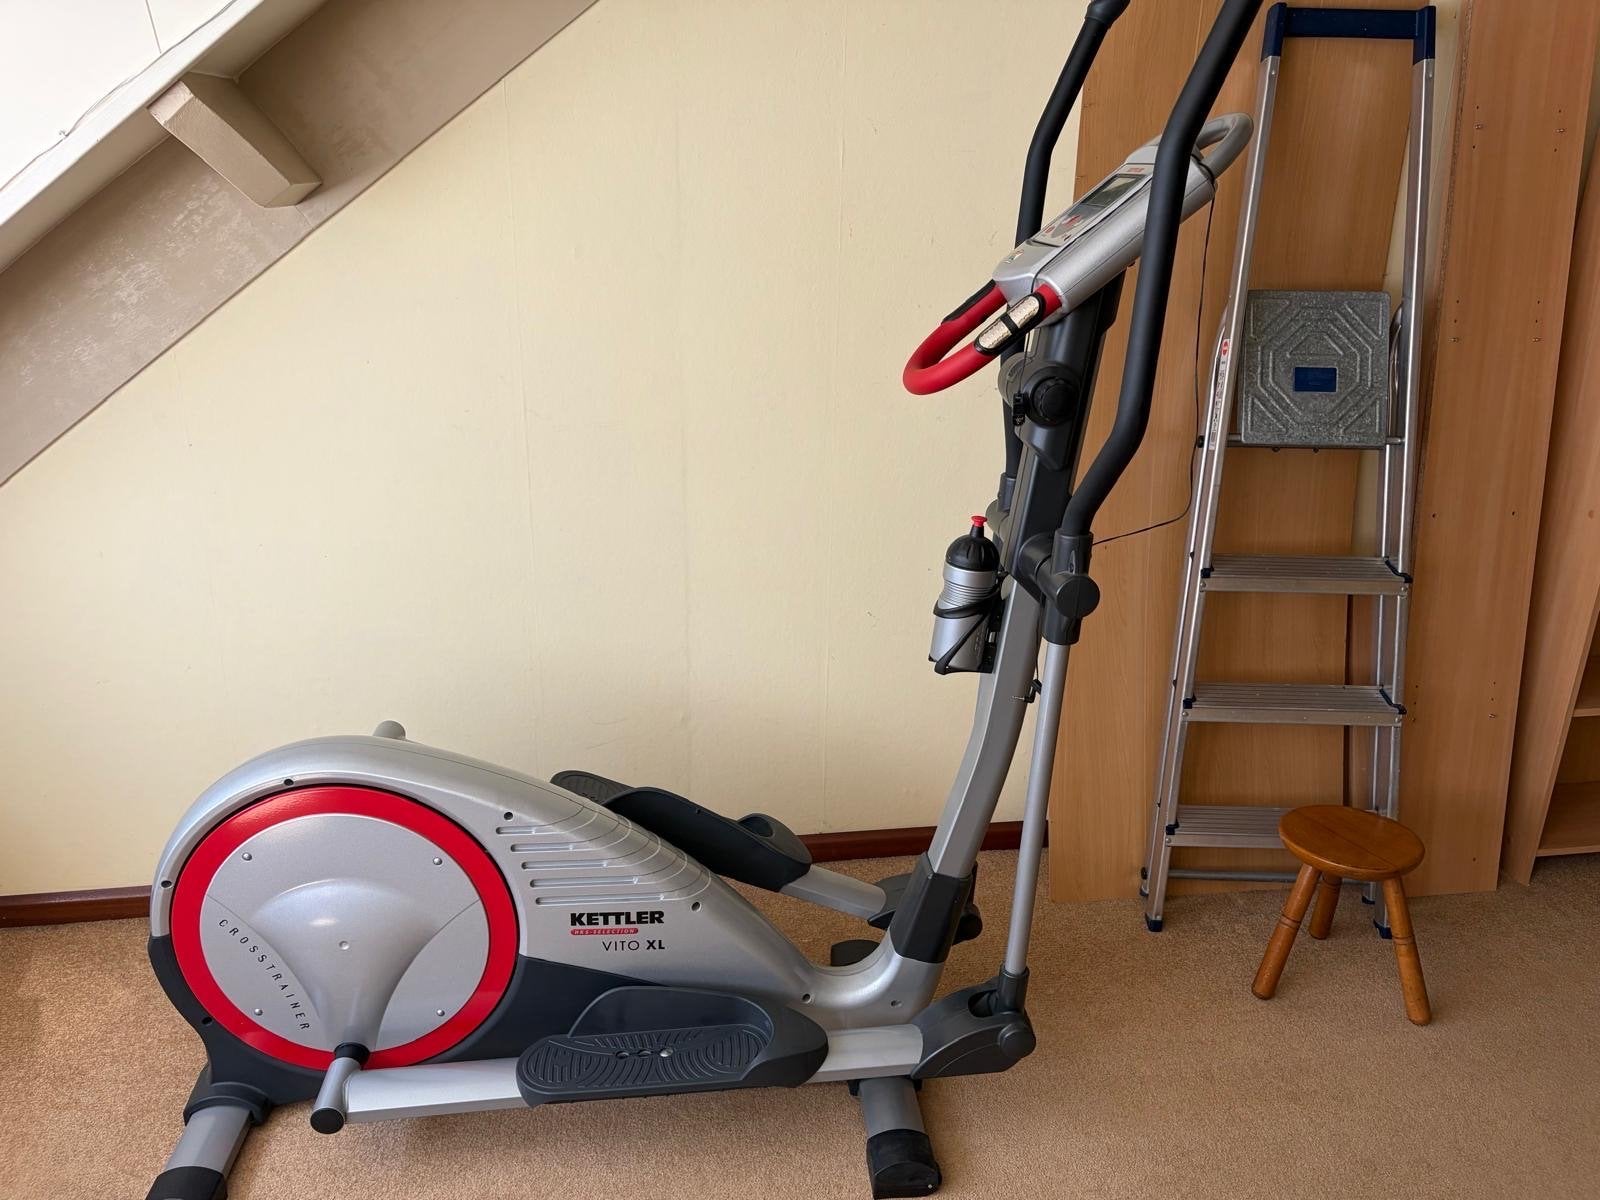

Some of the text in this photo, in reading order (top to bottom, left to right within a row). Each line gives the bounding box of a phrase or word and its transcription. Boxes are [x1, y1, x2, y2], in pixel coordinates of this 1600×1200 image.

[570, 911, 664, 926] KETTLER
[602, 939, 665, 951] VITO XL
[218, 919, 310, 1030] CROSSTRAINER
